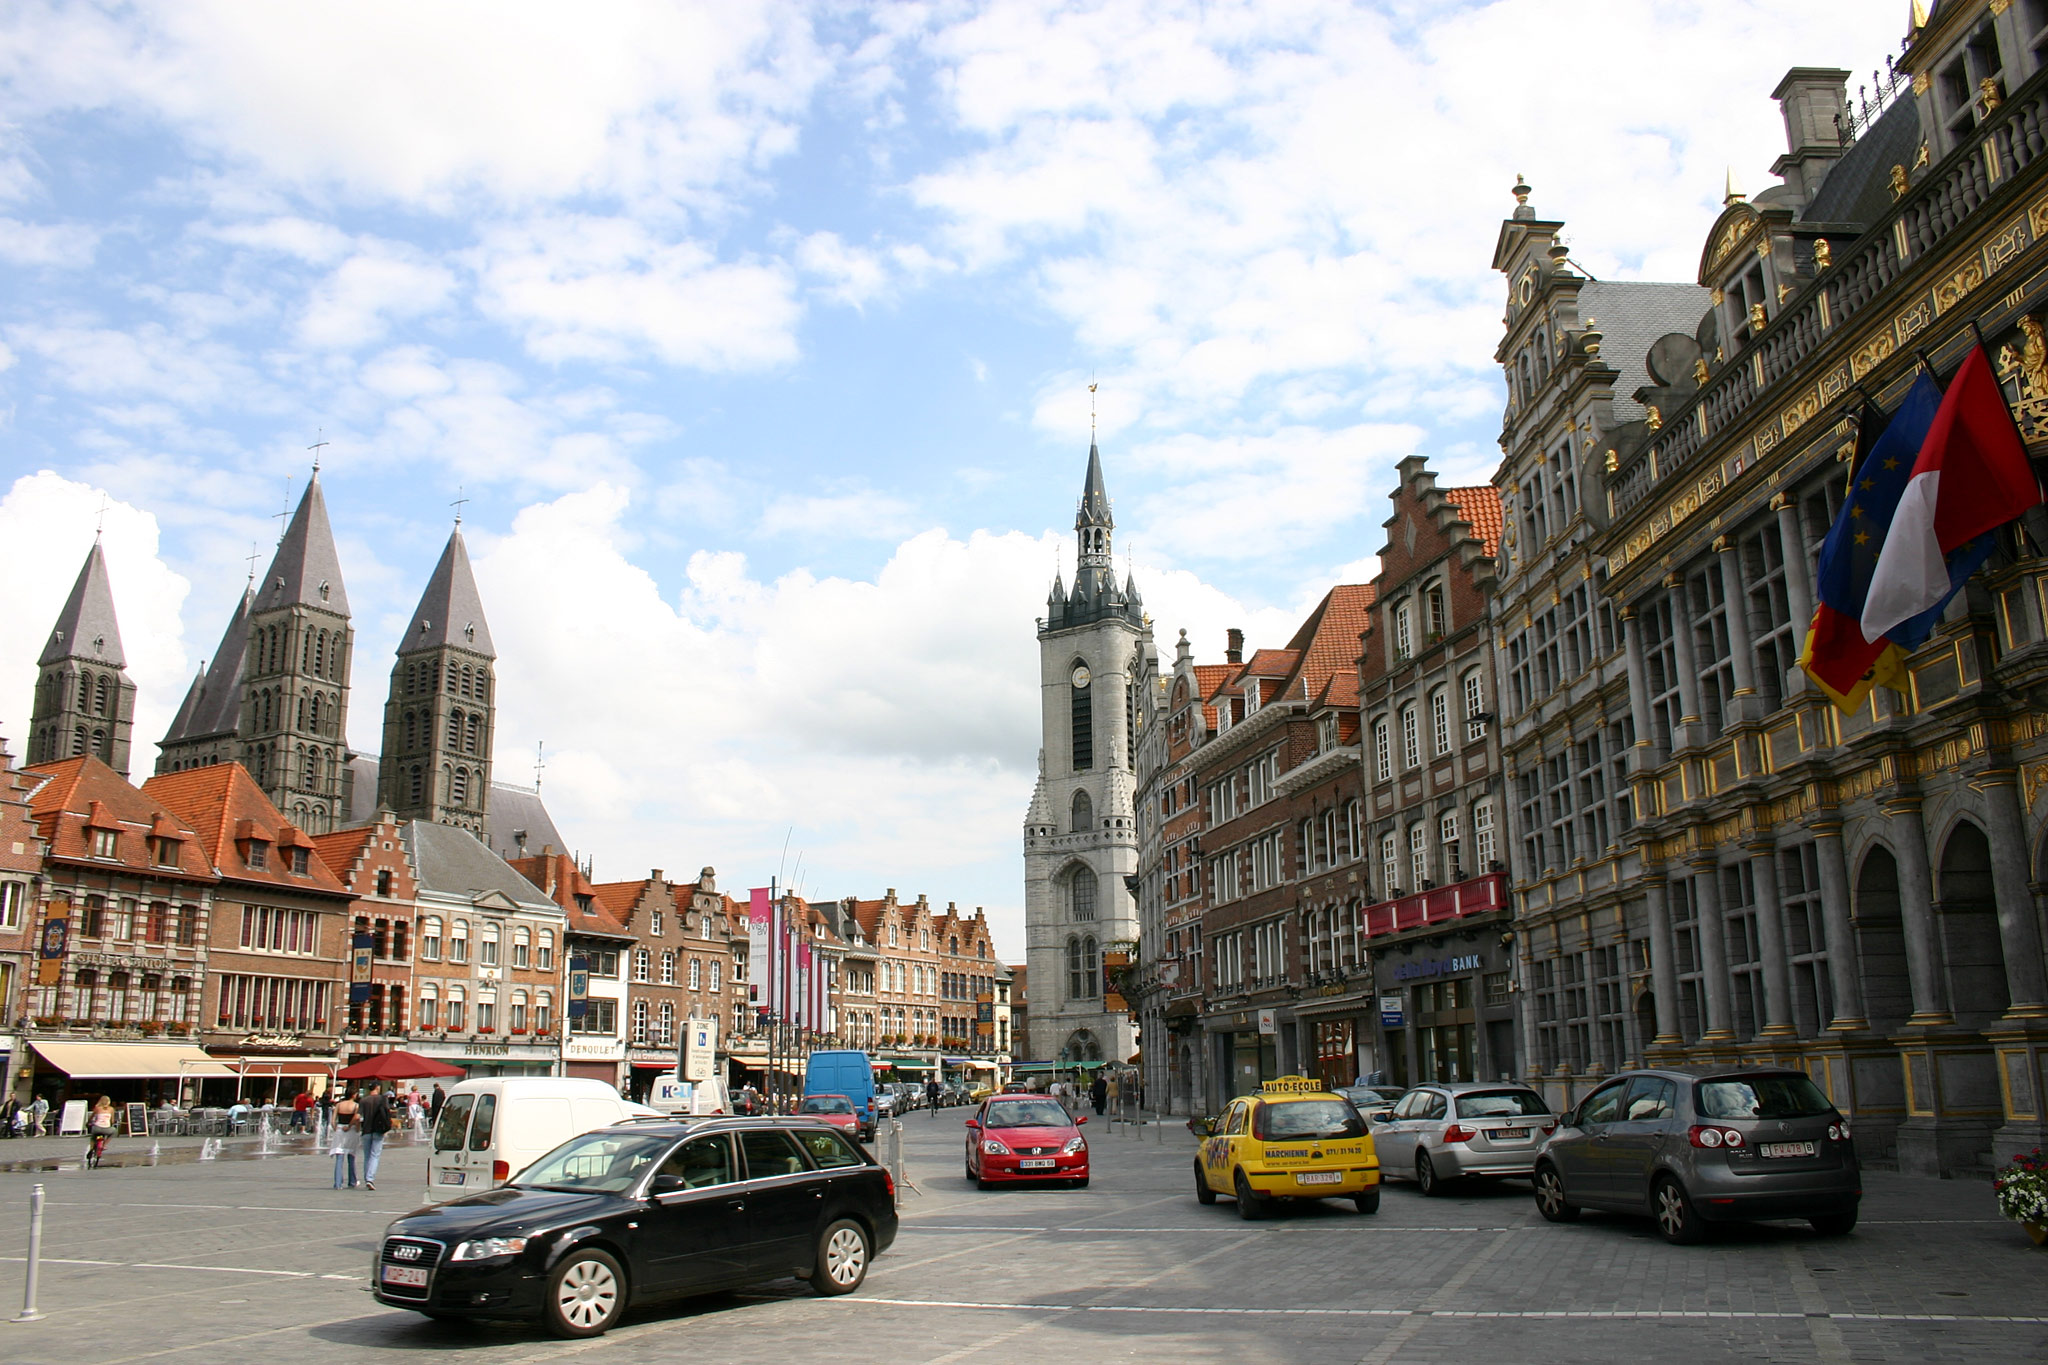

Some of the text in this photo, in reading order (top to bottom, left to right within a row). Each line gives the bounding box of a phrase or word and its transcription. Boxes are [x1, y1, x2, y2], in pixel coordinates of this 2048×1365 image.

[77, 953, 120, 966] STELLA
[1452, 954, 1480, 972] BANK
[696, 1022, 709, 1030] ZONE
[464, 1045, 510, 1056] HENRION
[1265, 1081, 1321, 1092] AUTO-ECOLE
[1265, 1149, 1309, 1158] MARCHIENNE
